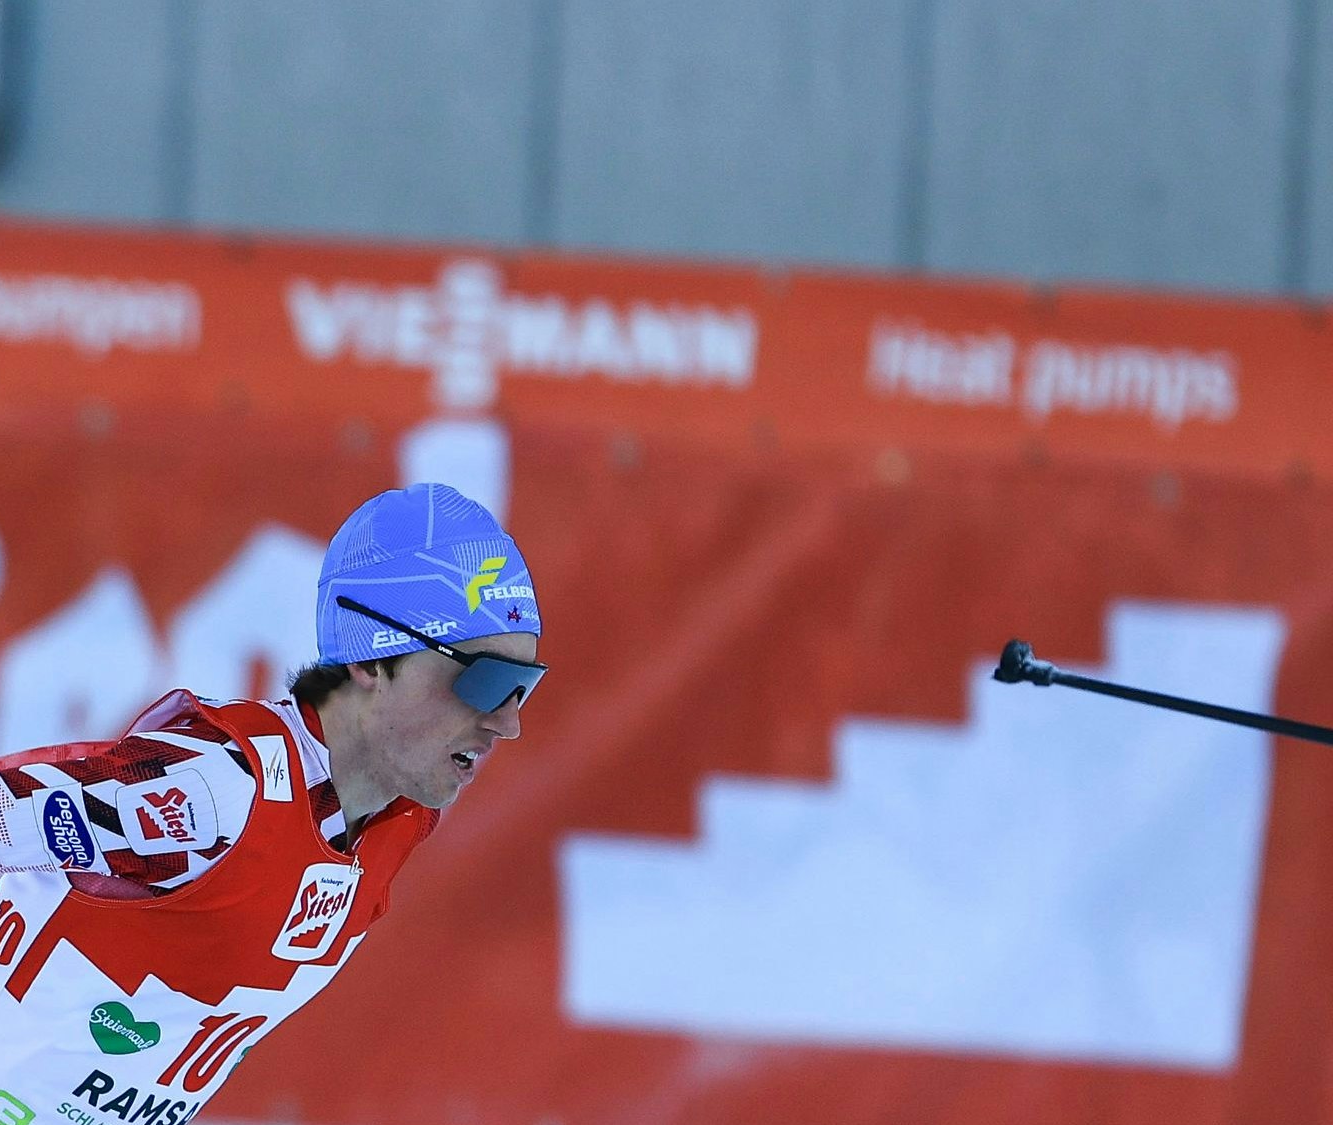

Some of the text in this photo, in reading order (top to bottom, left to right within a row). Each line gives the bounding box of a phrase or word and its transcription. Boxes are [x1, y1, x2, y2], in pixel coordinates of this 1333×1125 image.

[285, 260, 757, 408] VIESSMANN
[438, 645, 454, 657] uvex
[49, 815, 72, 853] shop
[55, 797, 92, 864] personal
[141, 787, 197, 843] Stiegl
[286, 880, 353, 935] Stiegl
[90, 1008, 157, 1052] Steiermark
[156, 1012, 269, 1094] 10
